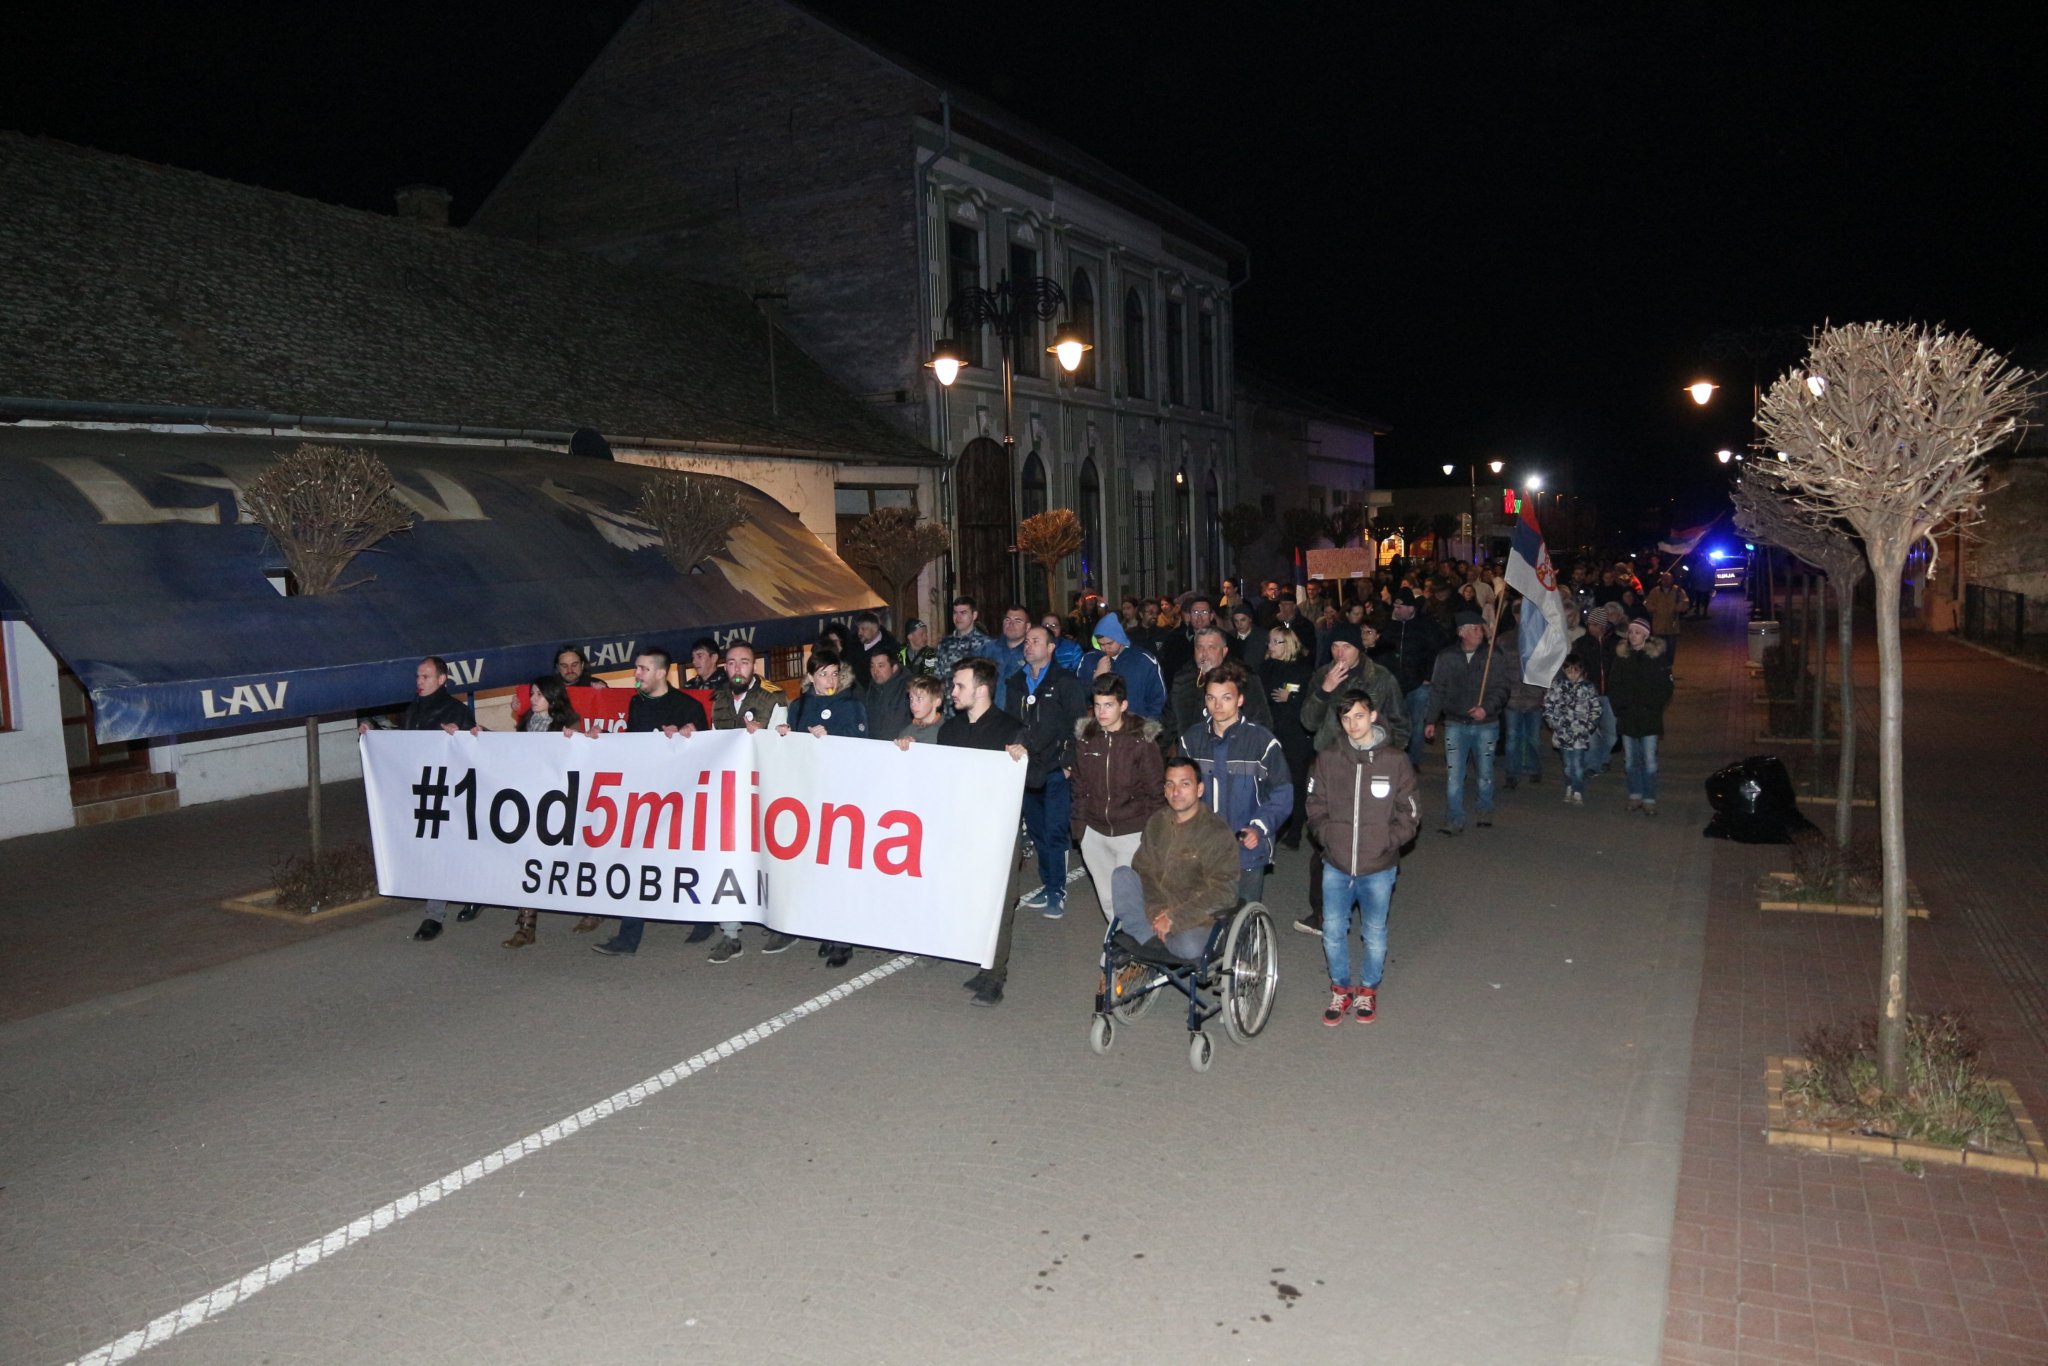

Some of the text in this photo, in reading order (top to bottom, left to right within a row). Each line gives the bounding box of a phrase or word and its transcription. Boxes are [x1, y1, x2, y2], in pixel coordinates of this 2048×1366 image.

[446, 658, 485, 687] AV
[583, 640, 636, 667] LAV
[200, 681, 288, 719] LAV
[412, 765, 923, 878] #1od5miliona
[522, 858, 769, 910] SRBOBRAN
